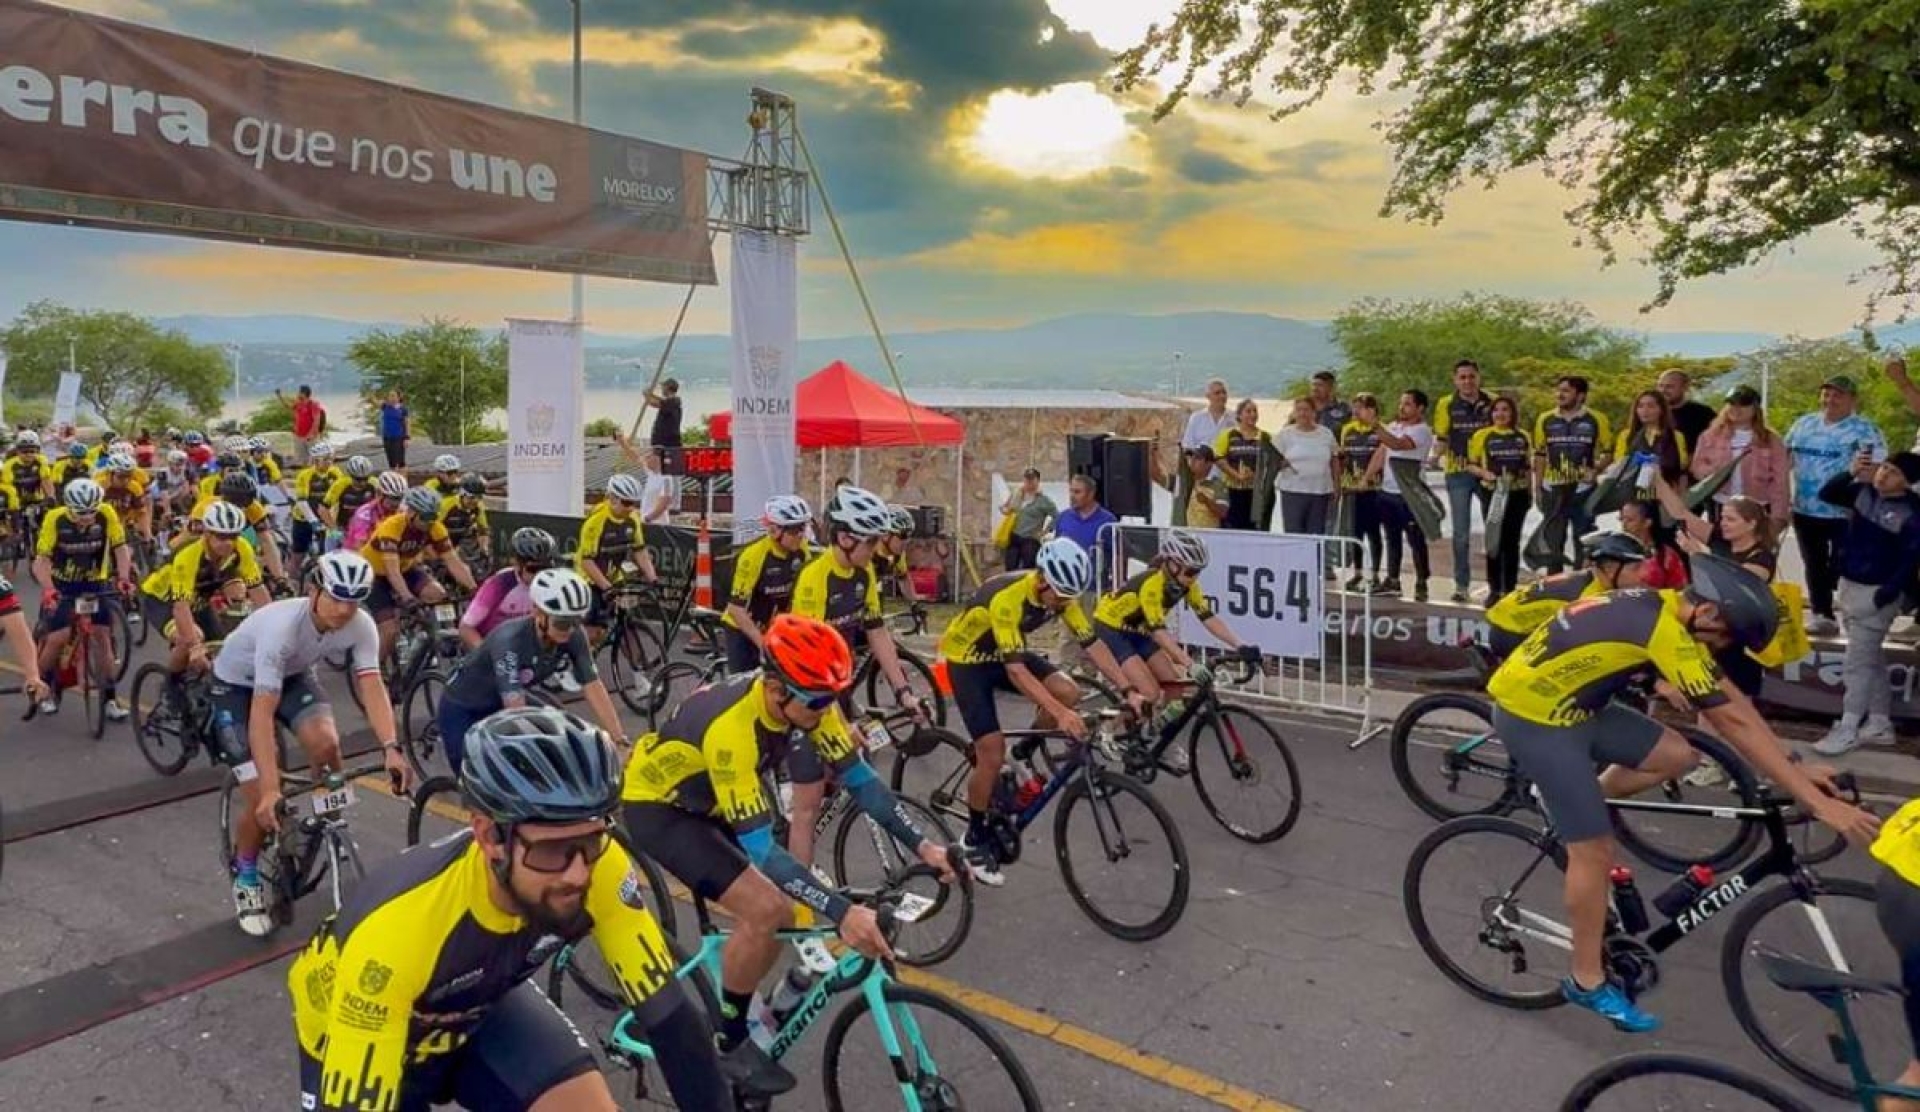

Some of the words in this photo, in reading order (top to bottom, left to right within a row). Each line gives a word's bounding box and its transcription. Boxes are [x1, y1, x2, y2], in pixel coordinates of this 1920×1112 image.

[233, 116, 336, 169] que
[351, 137, 434, 183] nos
[449, 148, 558, 202] une
[603, 175, 675, 202] MORELOS
[737, 396, 790, 415] INDEM
[513, 442, 566, 457] INDEM
[1228, 564, 1310, 623] 56.4
[324, 791, 347, 810] 194
[1676, 874, 1748, 934] FACTOR
